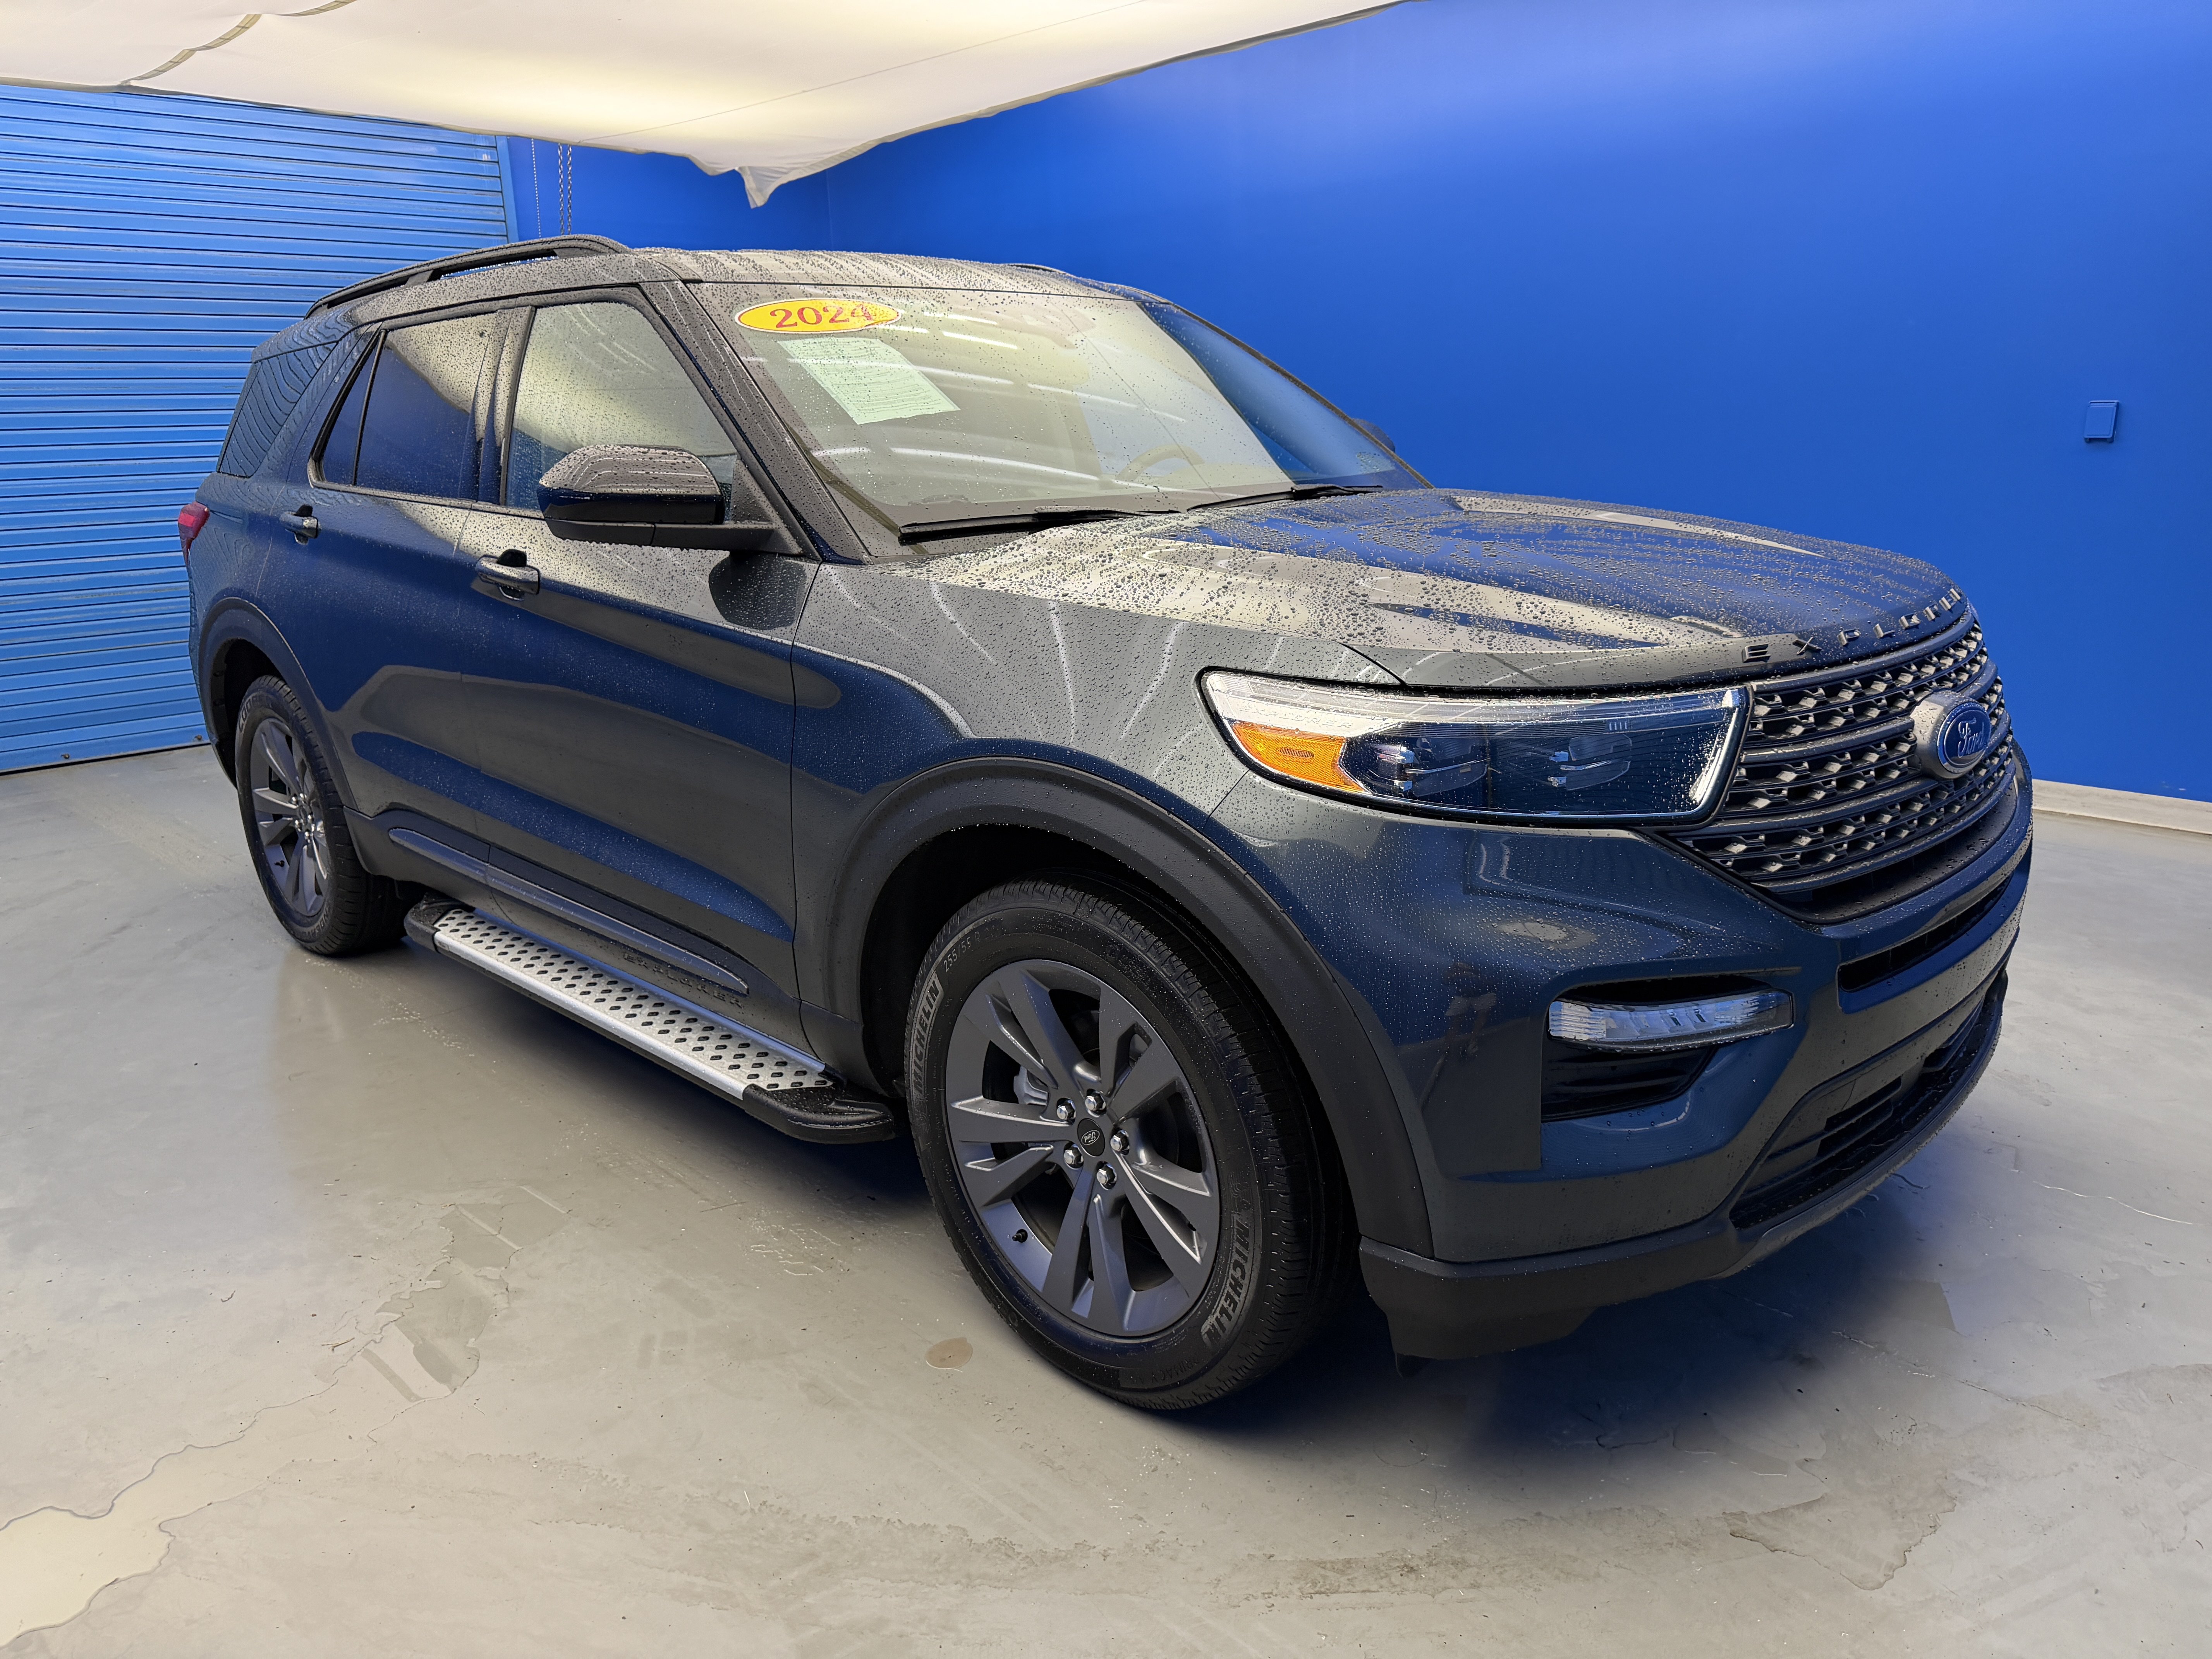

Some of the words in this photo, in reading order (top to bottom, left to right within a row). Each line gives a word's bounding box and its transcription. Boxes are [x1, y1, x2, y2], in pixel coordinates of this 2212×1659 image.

[769, 304, 874, 328] 2024
[1957, 717, 1985, 758] Ford
[624, 953, 744, 1009] EXPLORER
[913, 980, 940, 1093] MICHELIN
[1084, 1131, 1096, 1143] Ford
[1205, 1219, 1250, 1344] MICHELIN
